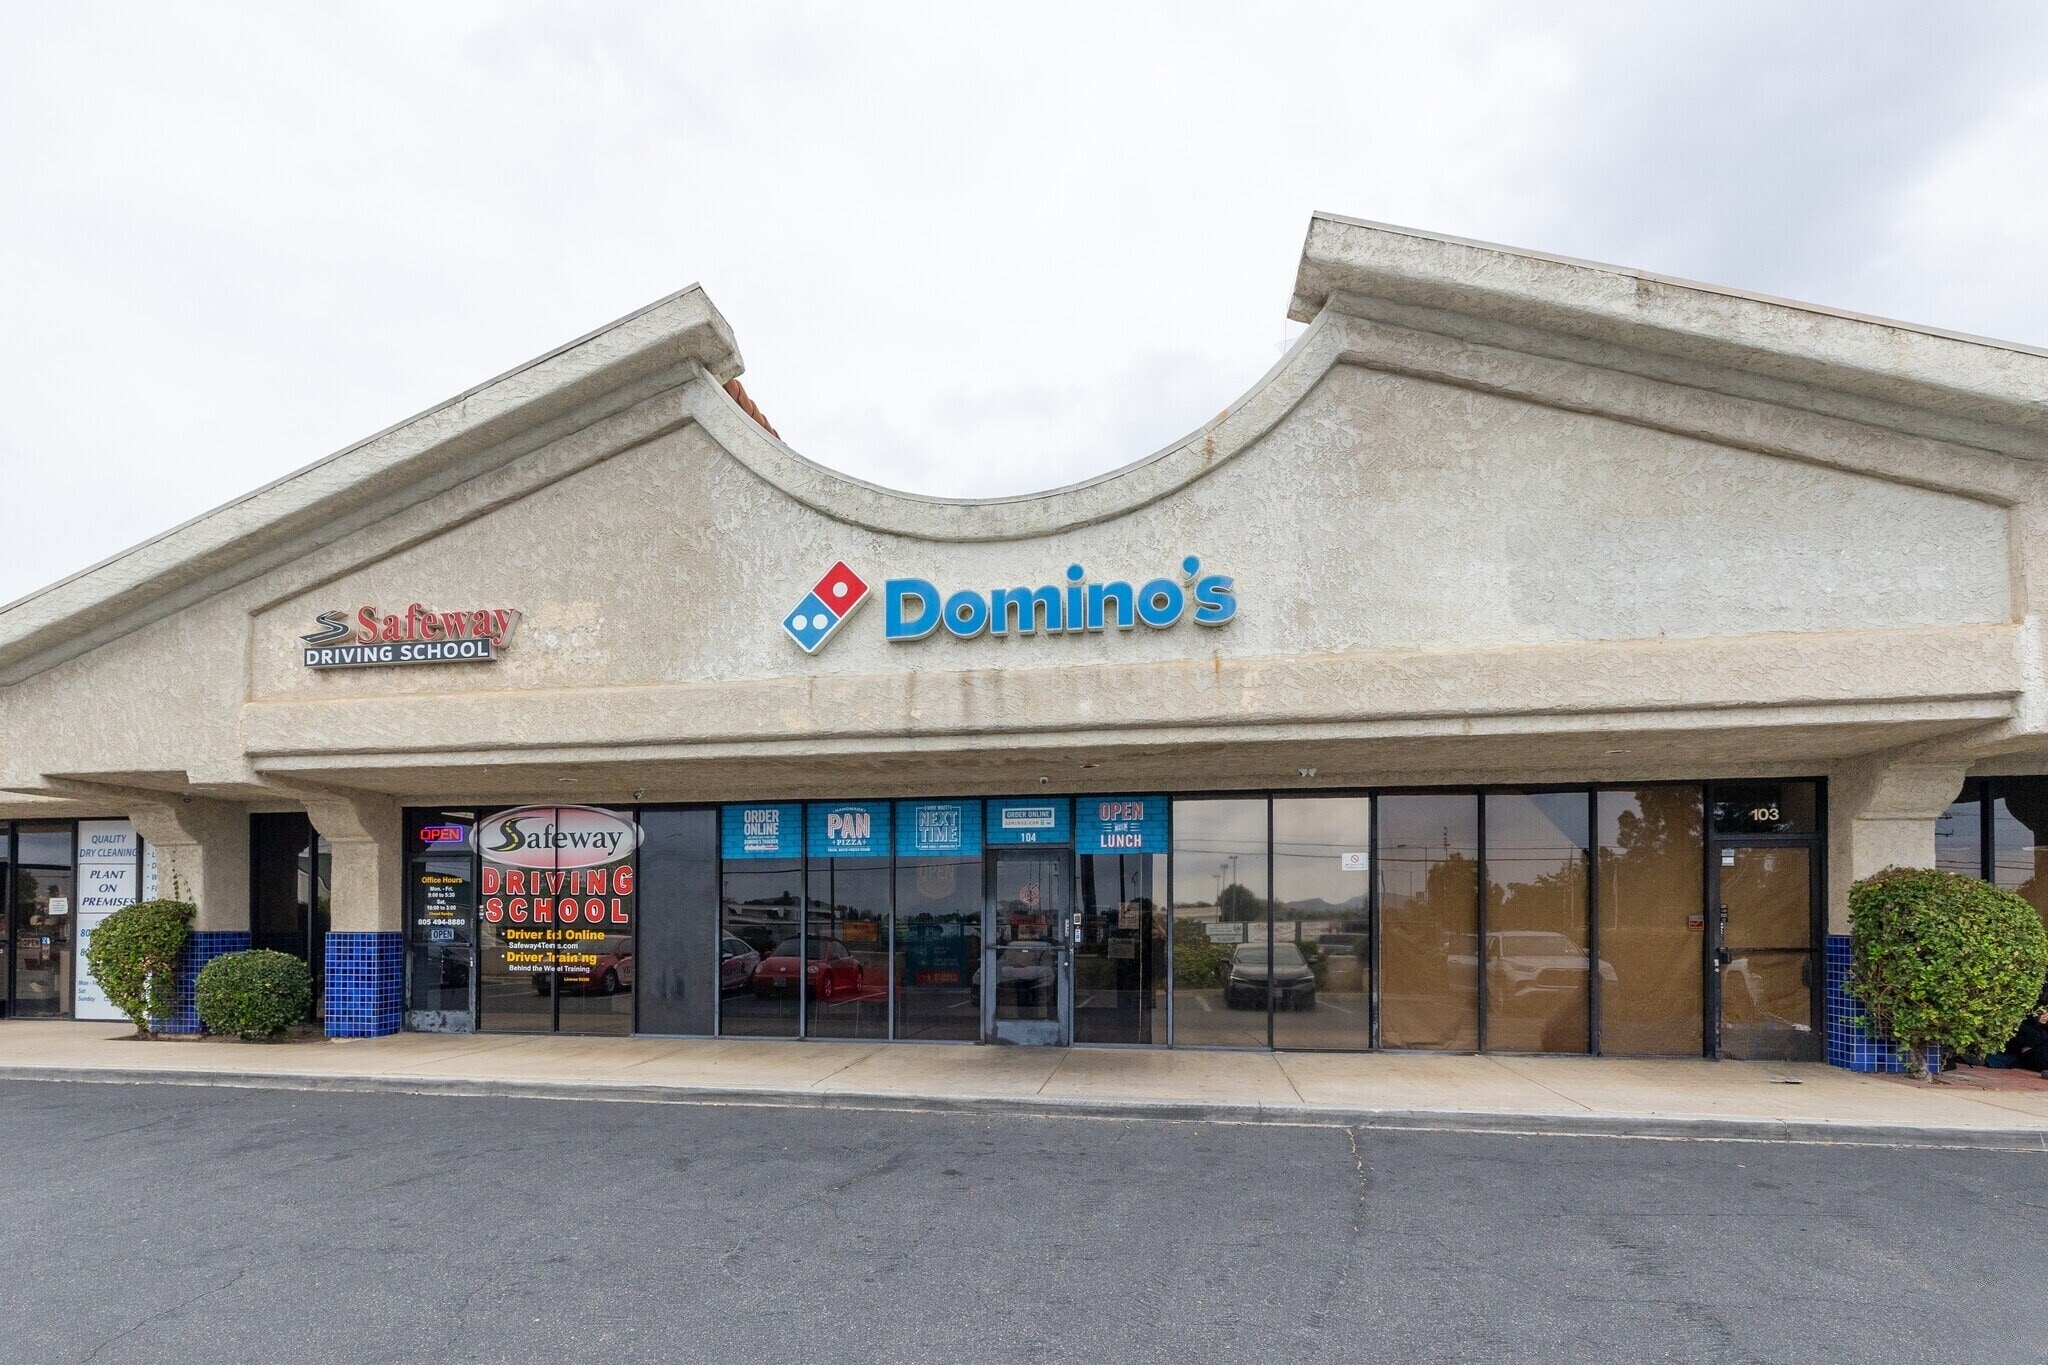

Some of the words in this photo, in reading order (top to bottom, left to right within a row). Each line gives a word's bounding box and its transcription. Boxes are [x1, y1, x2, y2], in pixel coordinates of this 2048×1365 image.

[885, 555, 1237, 641] Domino's
[357, 603, 515, 646] Safeway
[306, 646, 393, 666] DRIVING
[400, 641, 488, 661] SCHOOL
[744, 810, 779, 822] ORDER
[1099, 802, 1144, 821] OPEN
[1751, 809, 1779, 821] 103
[919, 811, 957, 826] NEXT
[744, 823, 779, 835] ONLINE
[828, 813, 870, 839] PAN
[91, 835, 127, 844] QUALITY
[420, 829, 460, 840] OPEN
[486, 817, 623, 856] Safeway
[919, 827, 957, 842] TIME
[1021, 832, 1036, 843] 104
[1100, 834, 1142, 848] LUNCH
[80, 849, 96, 857] DRY
[98, 849, 137, 857] CLEANING
[90, 871, 126, 879] PLANT
[482, 866, 633, 896] DRIVING
[99, 884, 117, 892] ON
[82, 897, 136, 906] PREMISES
[485, 898, 629, 923] SCHOOL
[507, 930, 543, 939] Driver
[546, 930, 562, 939] Ed
[566, 930, 605, 939] Online
[22, 939, 40, 947] OPEN
[507, 952, 543, 962] Driver
[564, 965, 590, 974] Training
